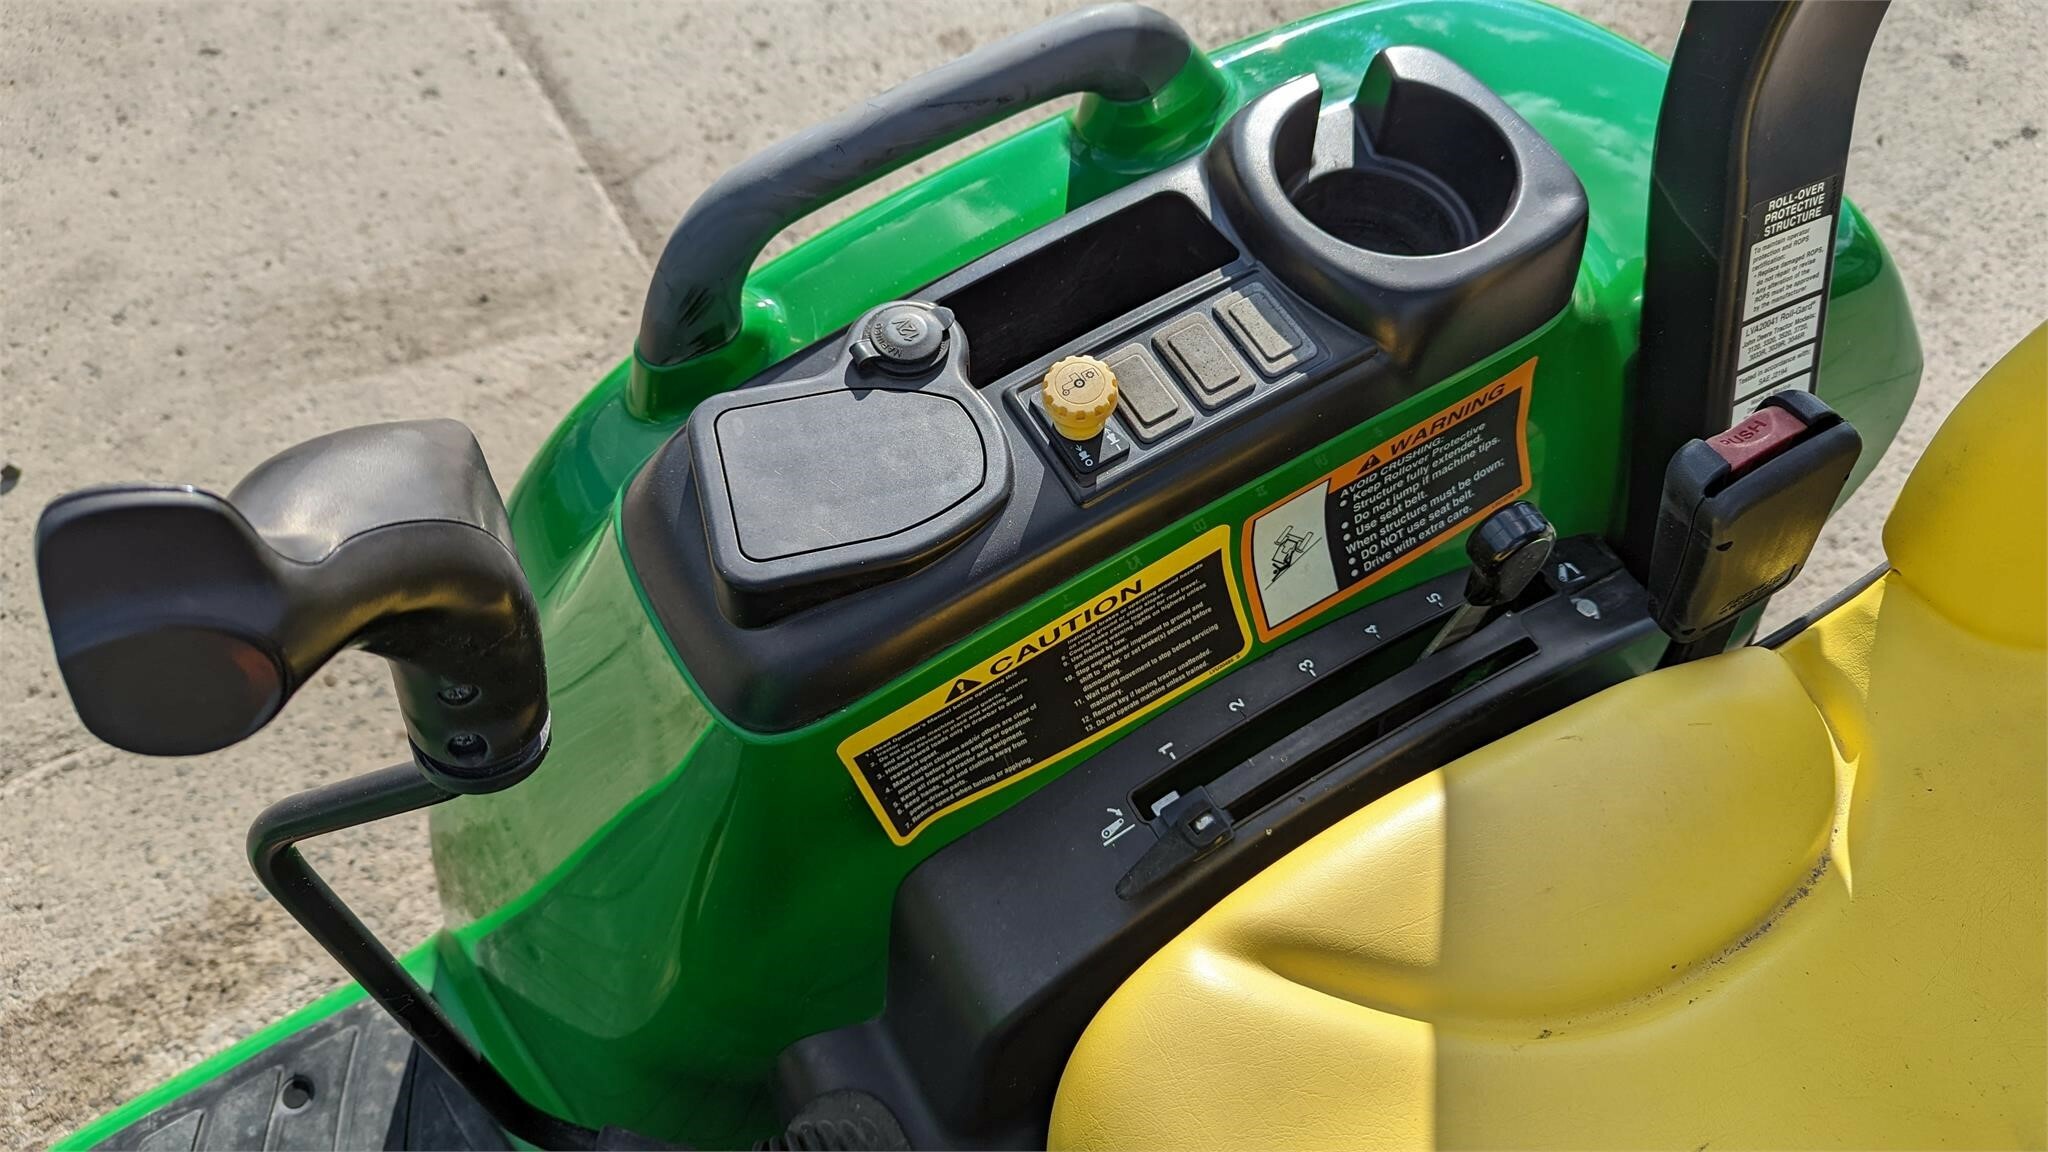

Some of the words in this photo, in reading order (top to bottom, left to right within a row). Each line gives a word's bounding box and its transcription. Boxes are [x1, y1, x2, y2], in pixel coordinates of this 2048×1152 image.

[1764, 193, 1825, 224] PROTECTIVE
[1768, 181, 1825, 211] ROLL-OVER
[1763, 206, 1822, 238] STRUCTURE
[891, 318, 921, 342] 12V
[1390, 382, 1506, 456] WARNING
[1719, 420, 1768, 445] PUSH
[1340, 472, 1378, 498] AVOID
[1353, 481, 1381, 502] Keep
[1384, 454, 1429, 484] Rollover
[1432, 423, 1486, 458] Protective
[1353, 479, 1404, 513] Structure
[1406, 464, 1430, 483] fully
[1432, 434, 1483, 468] extended.
[1354, 511, 1370, 524] Do
[1372, 498, 1391, 514] not
[1392, 482, 1420, 505] jump
[1422, 474, 1429, 485] if
[1432, 449, 1477, 480] machine
[1478, 437, 1501, 453] tips.
[1345, 532, 1378, 554] When
[1379, 503, 1428, 536] structure
[1429, 485, 1457, 507] must
[1457, 478, 1472, 490] be
[1355, 519, 1378, 536] Use
[1379, 503, 1403, 523] seat
[1404, 490, 1428, 508] belt.
[1360, 544, 1378, 560] DO
[1380, 527, 1404, 549] NOT
[1406, 518, 1426, 534] use
[1428, 502, 1451, 521] seat
[1452, 489, 1475, 507] belt.
[1363, 551, 1392, 572] Drive
[1393, 536, 1417, 554] with
[1418, 520, 1445, 540] extra
[1447, 505, 1472, 524] care.
[1426, 592, 1442, 605] 5
[989, 580, 1143, 676] CAUTION
[1064, 674, 1075, 682] 10.
[1075, 665, 1090, 677] Stop
[1090, 654, 1112, 668] engine
[1111, 644, 1129, 657] lower
[1129, 624, 1163, 646] implement
[1169, 607, 1191, 625] ground
[1191, 601, 1204, 612] and
[1079, 672, 1094, 684] shift
[1123, 652, 1130, 660] or
[1130, 646, 1141, 656] set
[1140, 632, 1167, 650] brake(s)
[1166, 617, 1192, 636] securely
[1191, 607, 1212, 621] before
[1364, 623, 1378, 635] 4
[1073, 698, 1085, 707] 11.
[1084, 689, 1101, 701] Wait
[1099, 684, 1110, 693] for
[1110, 678, 1119, 688] all
[1118, 661, 1151, 683] movement
[1158, 650, 1172, 661] stop
[1171, 639, 1192, 653] before
[1191, 623, 1219, 642] servicing
[1081, 715, 1092, 724] 12.
[1092, 701, 1118, 718] Remove
[1117, 695, 1129, 705] key
[1129, 690, 1135, 698] if
[1134, 679, 1158, 695] leaving
[1157, 667, 1177, 683] tractor
[1177, 648, 1212, 671] unattended.
[1082, 668, 1122, 692] dismounting.
[1298, 658, 1314, 673] 3
[1085, 724, 1096, 732] 13.
[1095, 718, 1106, 727] Do
[1105, 711, 1117, 722] not
[1116, 699, 1140, 716] operate
[1139, 685, 1166, 703] machine
[1165, 673, 1186, 688] unless
[1185, 660, 1209, 677] trained.
[1089, 688, 1124, 709] machinery.
[1228, 698, 1245, 713] 2
[1158, 741, 1174, 755] 1
